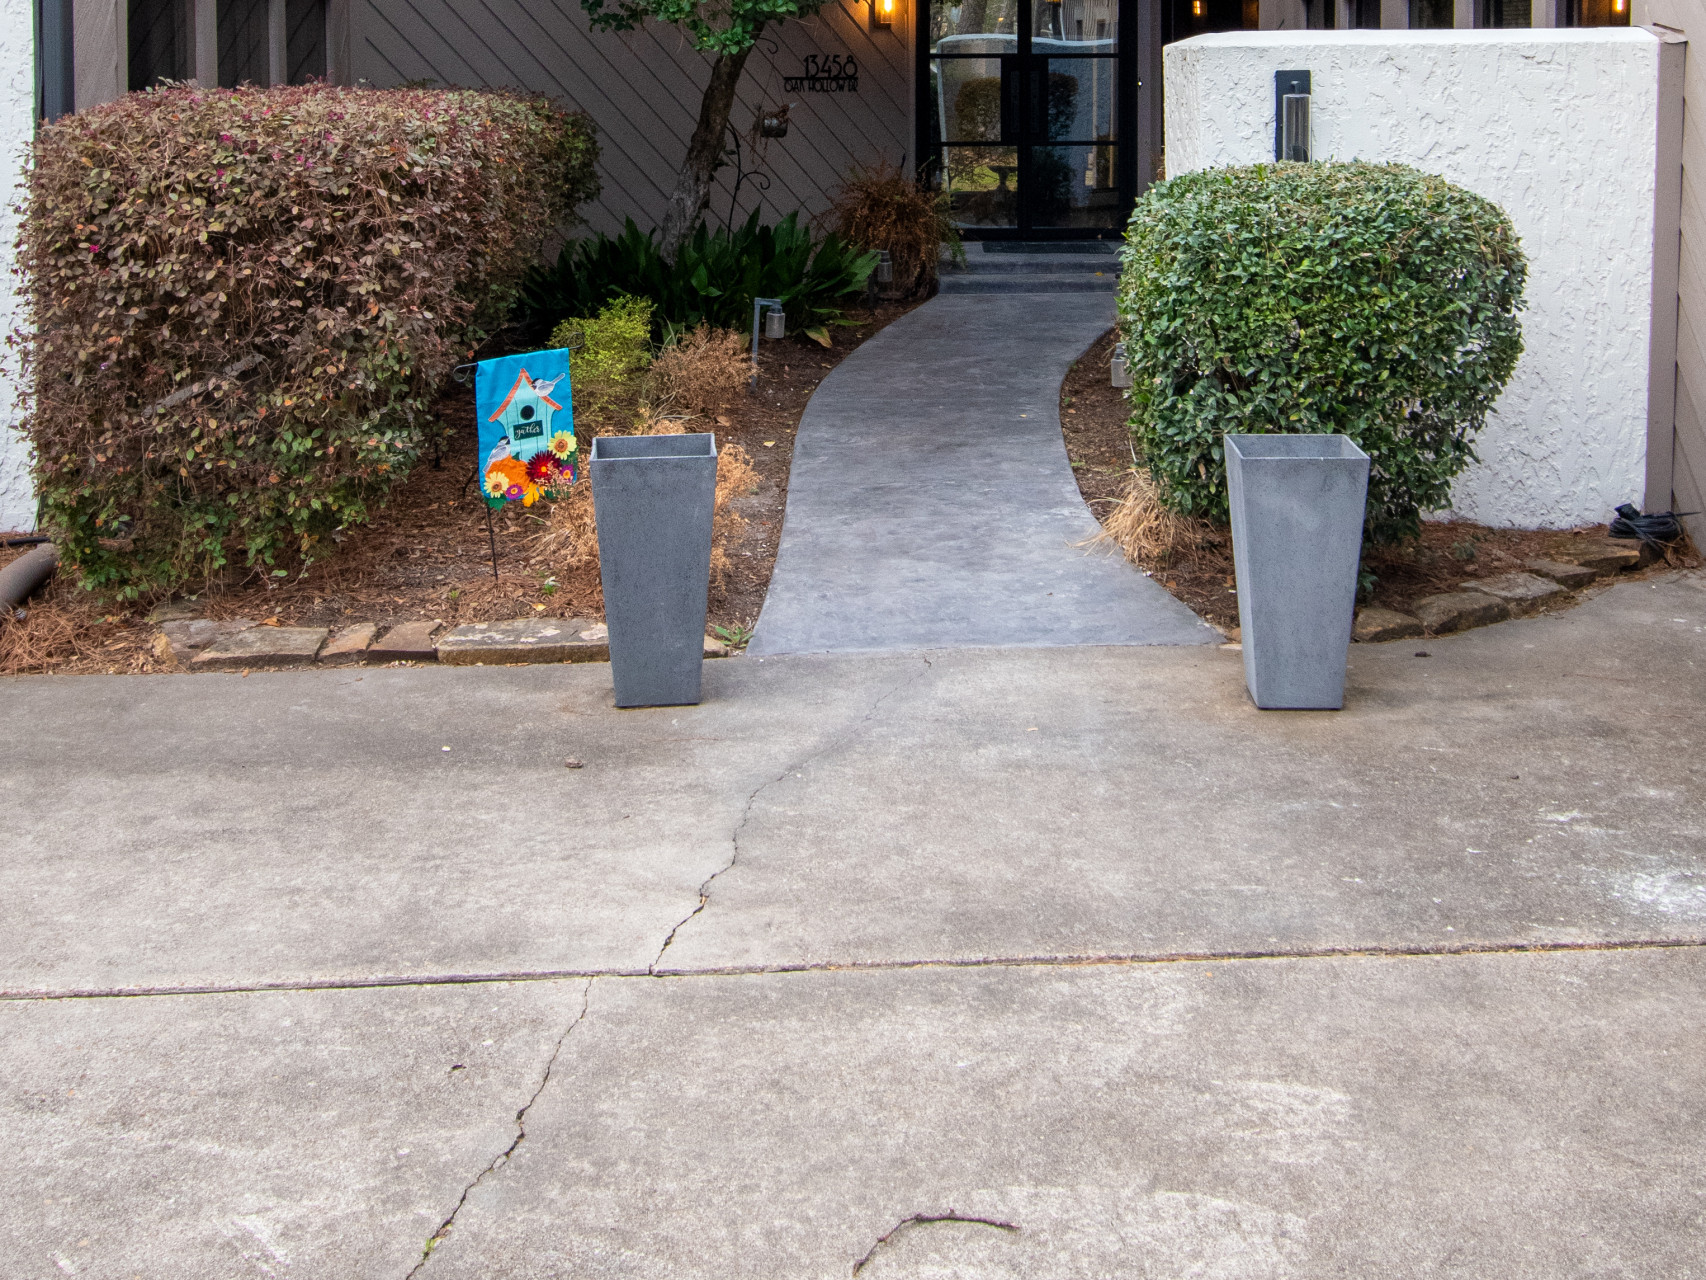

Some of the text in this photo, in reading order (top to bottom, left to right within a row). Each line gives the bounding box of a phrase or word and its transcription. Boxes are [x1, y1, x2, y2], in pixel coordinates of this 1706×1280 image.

[803, 54, 858, 77] 13458
[784, 79, 805, 92] OAK
[514, 423, 541, 440] gather
